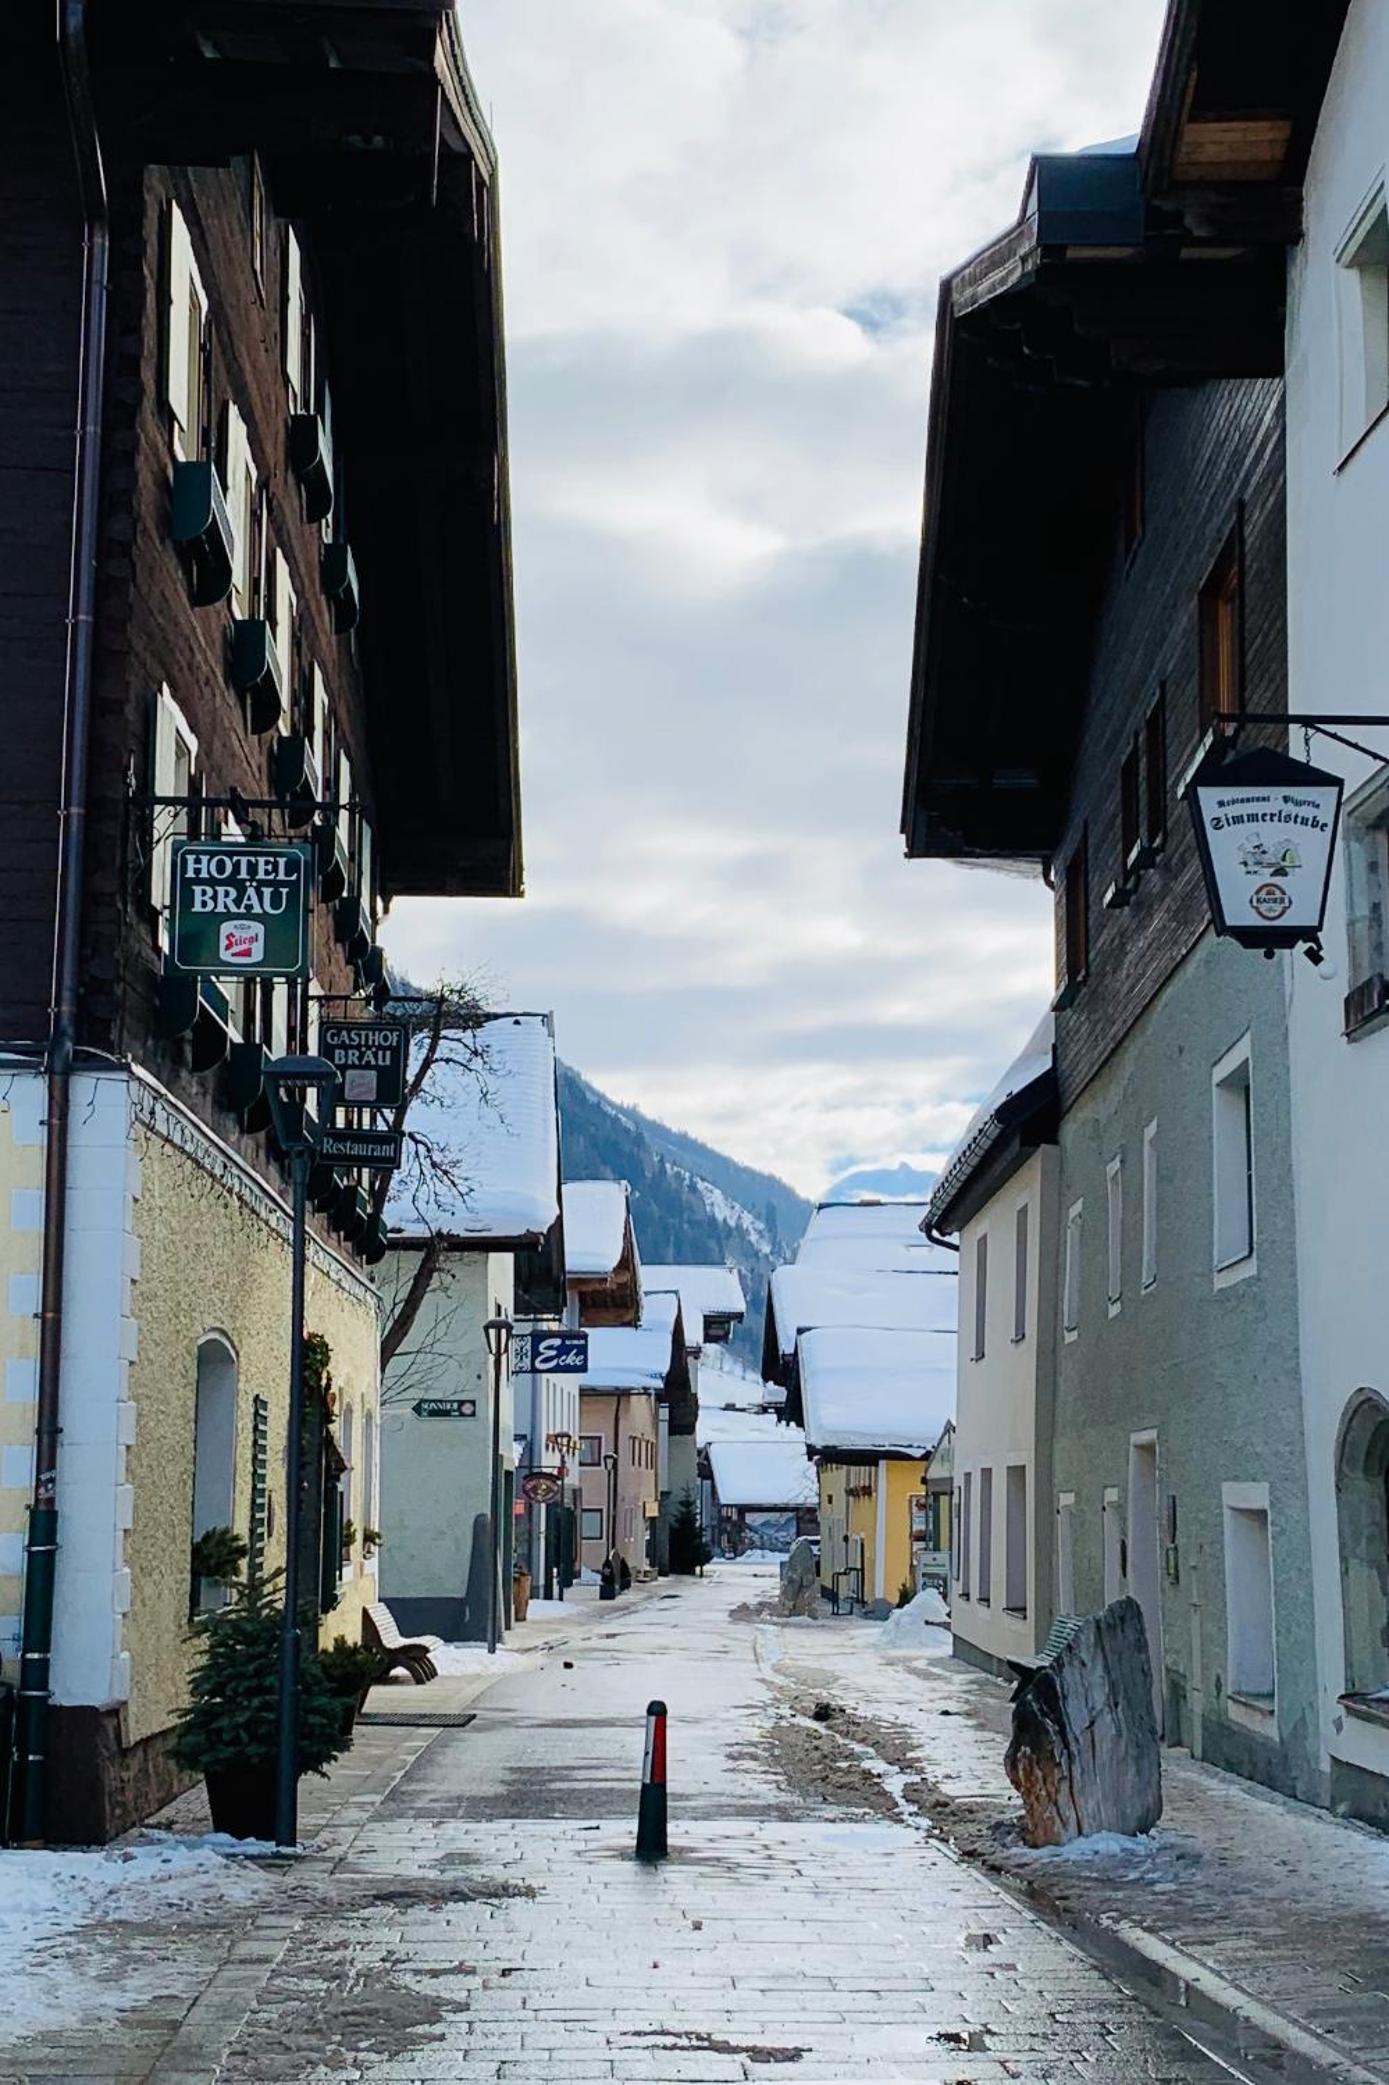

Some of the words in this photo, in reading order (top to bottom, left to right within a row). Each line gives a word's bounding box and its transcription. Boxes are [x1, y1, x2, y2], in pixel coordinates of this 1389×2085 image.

[184, 854, 298, 880] HOTEL
[191, 881, 290, 915] BRÄU
[225, 932, 259, 952] Stiegl
[326, 1029, 400, 1047] GASTHOF
[334, 1046, 392, 1066] BRÄU
[322, 1136, 396, 1158] Restaurant
[535, 1338, 585, 1370] Ecke
